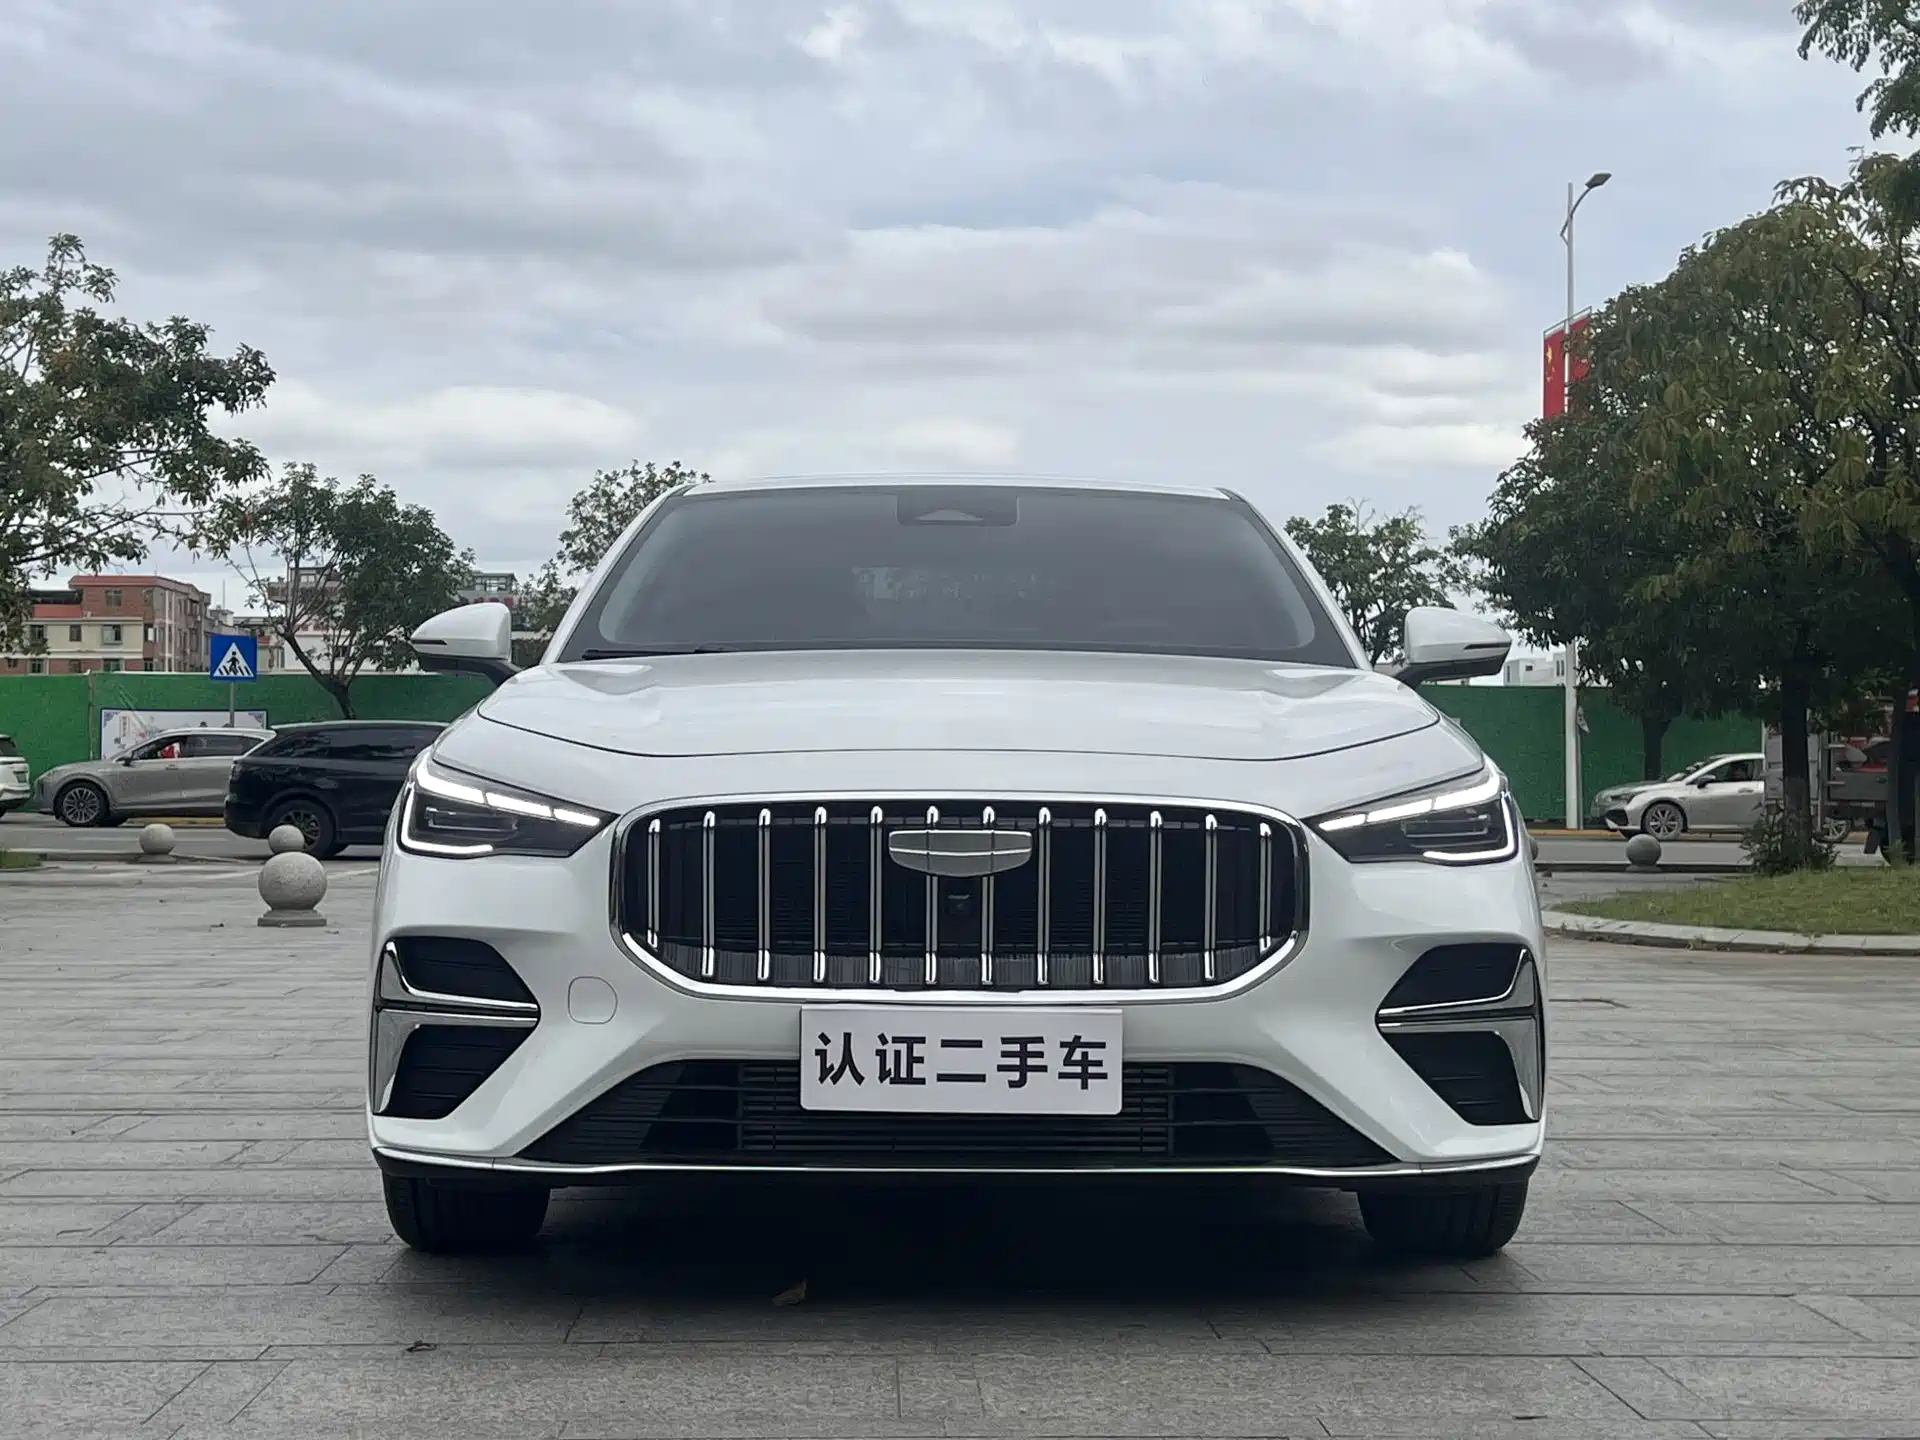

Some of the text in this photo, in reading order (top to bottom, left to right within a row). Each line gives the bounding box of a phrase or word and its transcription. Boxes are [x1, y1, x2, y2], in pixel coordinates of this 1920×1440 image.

[814, 1031, 1109, 1090] 认证二手车
